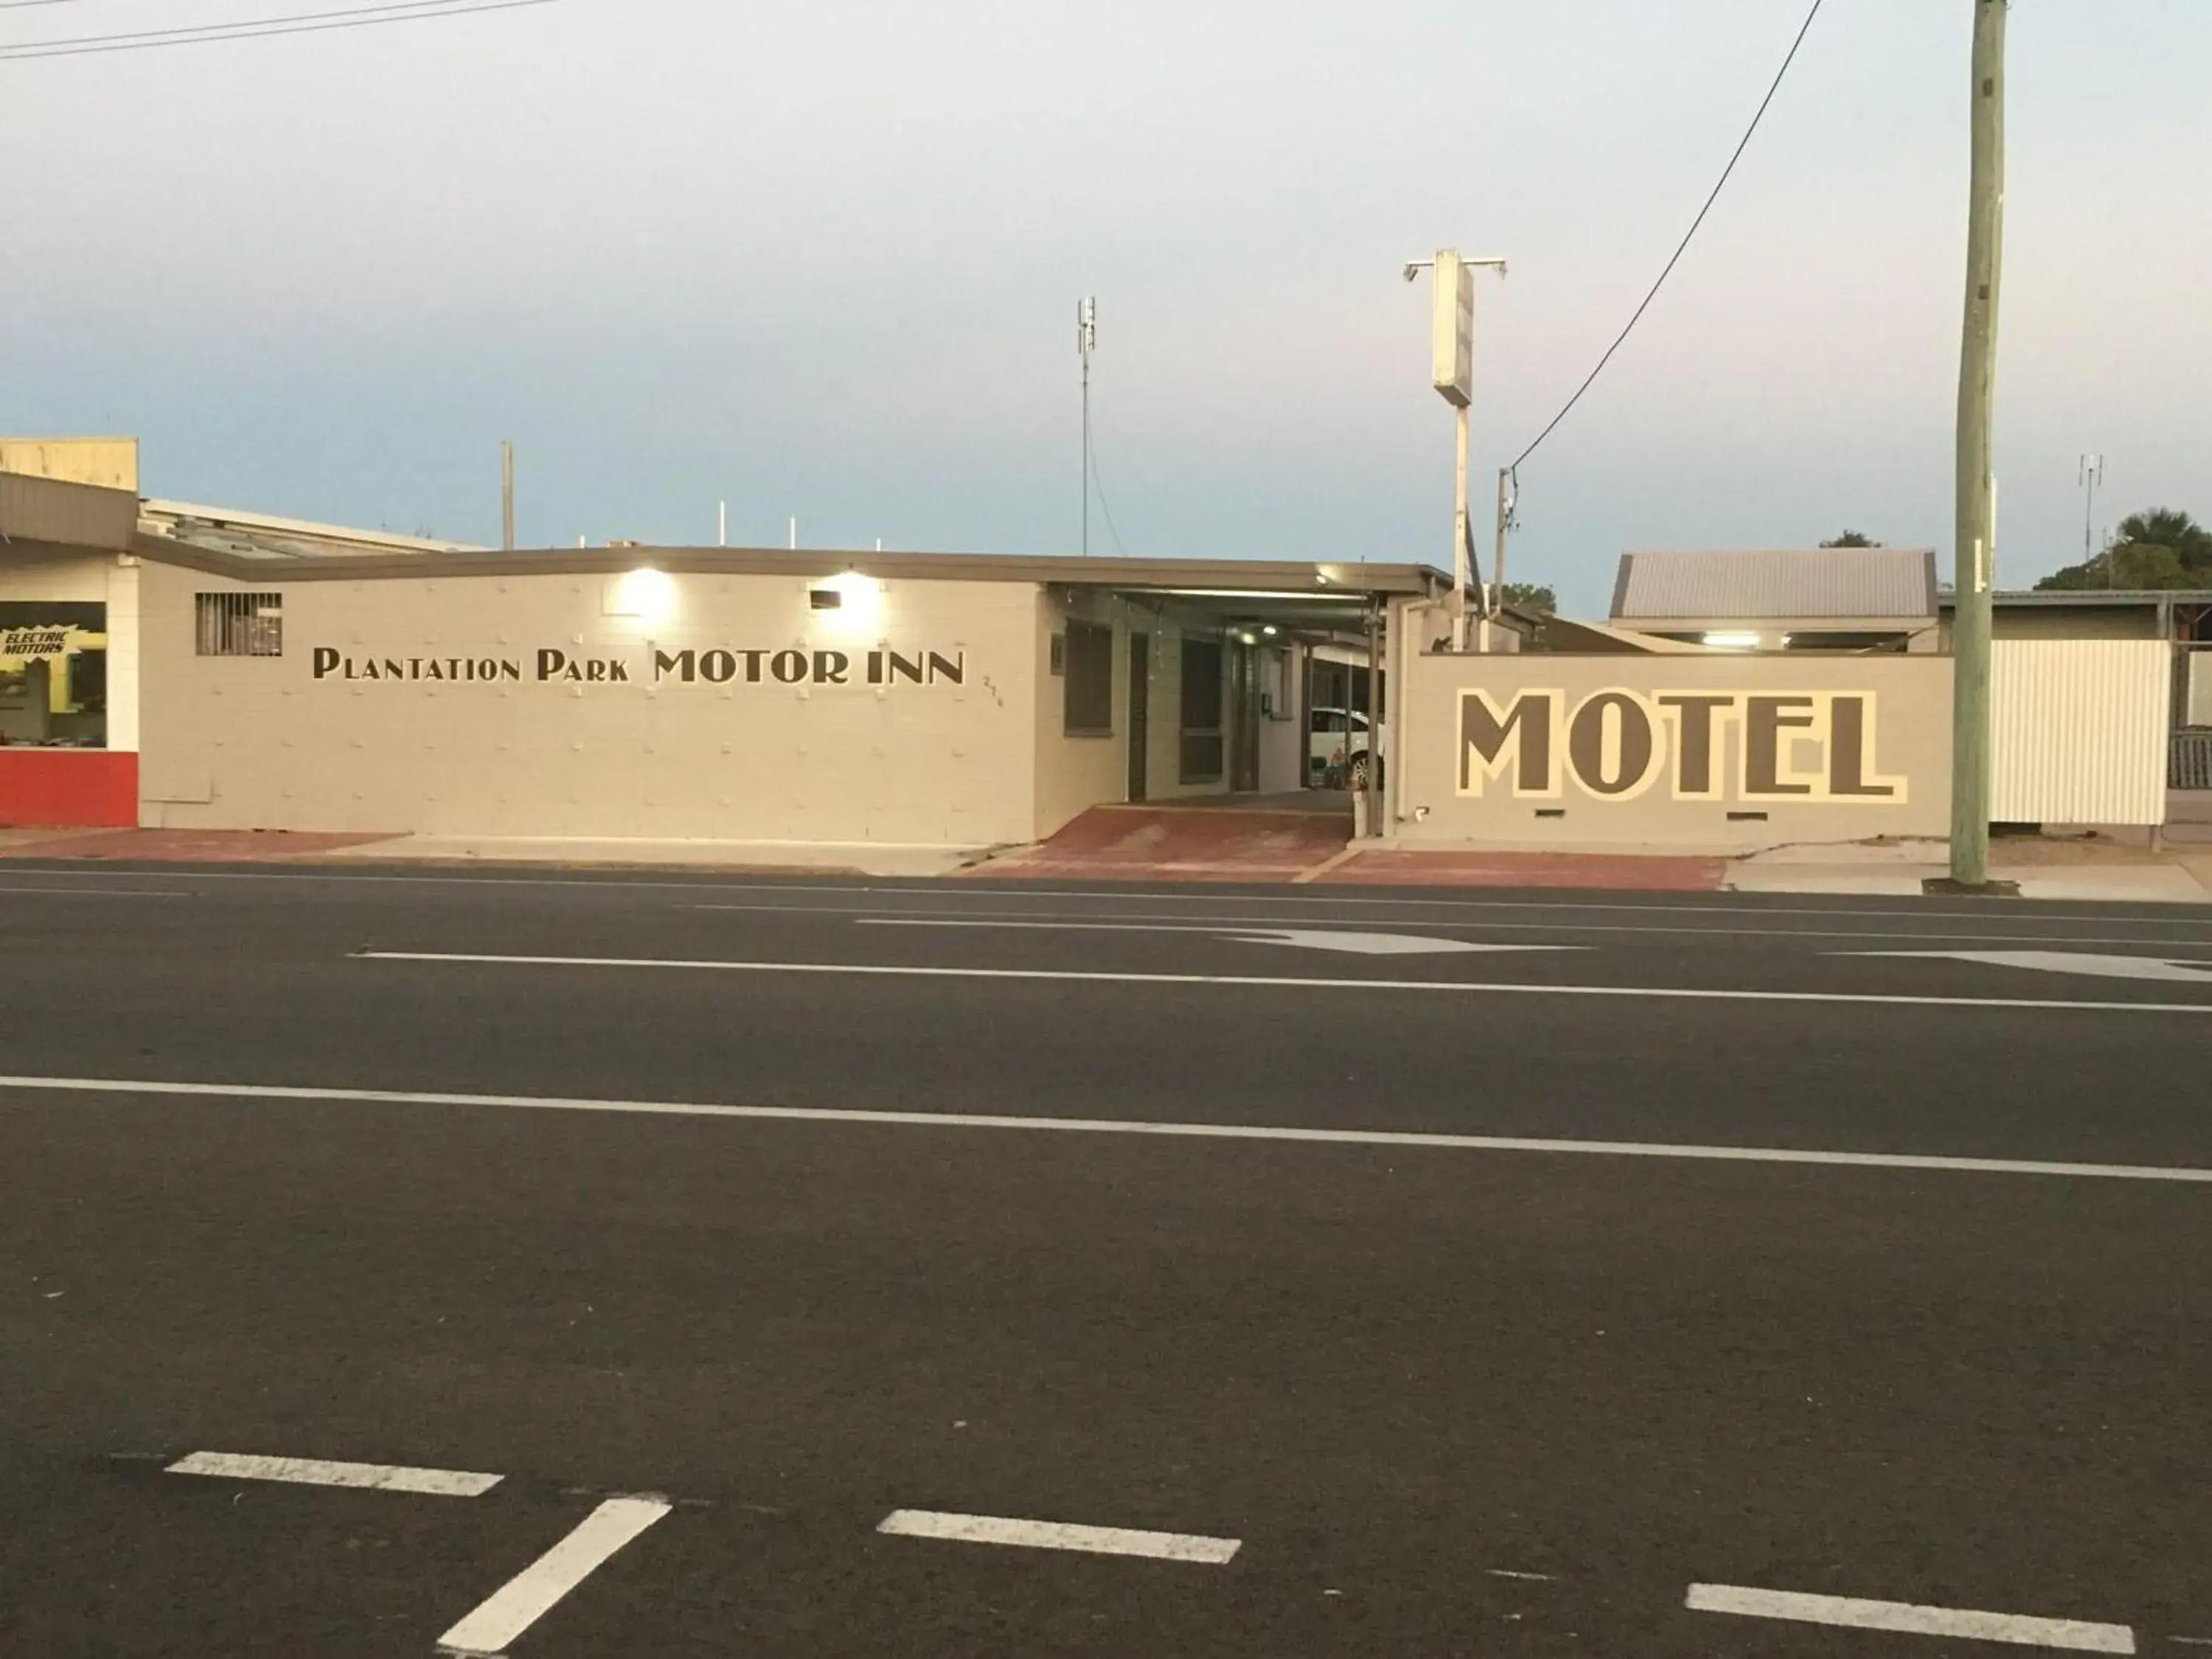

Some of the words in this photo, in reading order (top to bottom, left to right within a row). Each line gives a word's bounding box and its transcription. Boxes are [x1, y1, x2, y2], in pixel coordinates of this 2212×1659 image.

[3, 643, 65, 655] MOTORS
[4, 631, 68, 644] ELECTRIC
[313, 647, 521, 681] PLANTATION
[537, 648, 630, 682] PARK
[654, 649, 849, 684] MOTOR
[867, 650, 964, 684] INN
[1459, 691, 1896, 797] MOTEL
